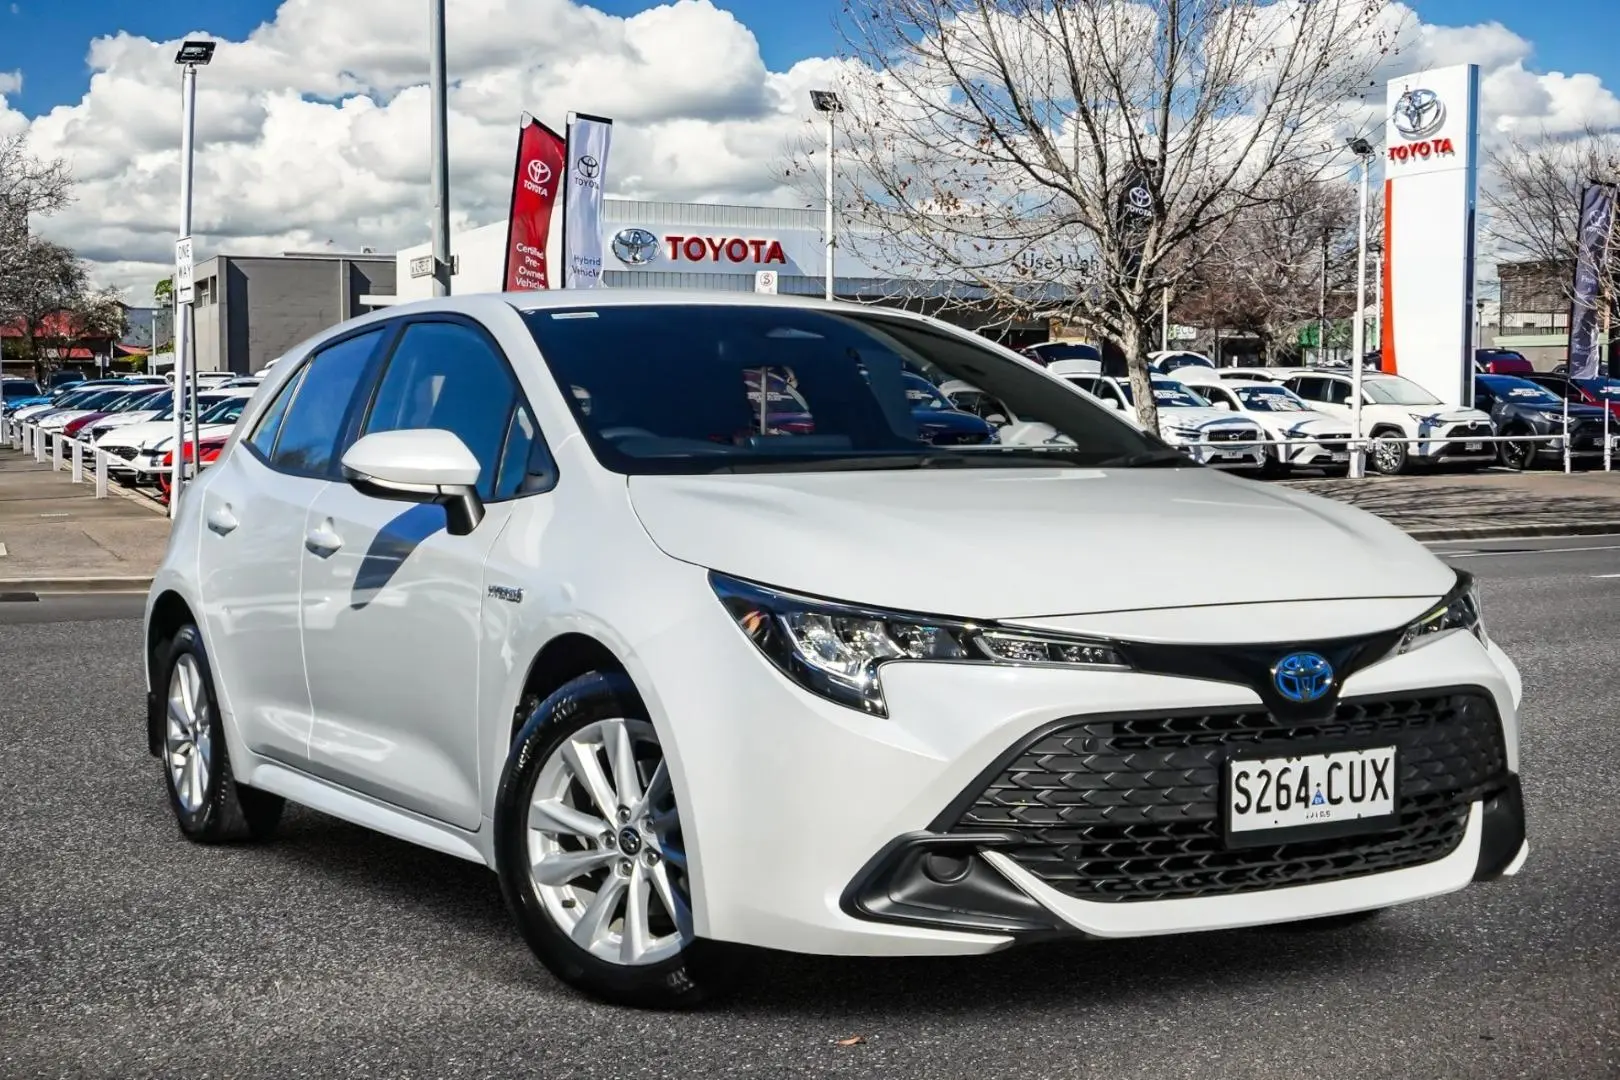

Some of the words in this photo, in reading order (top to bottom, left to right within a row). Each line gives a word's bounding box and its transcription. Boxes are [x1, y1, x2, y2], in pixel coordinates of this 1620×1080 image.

[1388, 138, 1454, 161] TOYOTA
[523, 180, 548, 197] TOYOTA
[575, 177, 600, 190] TOYOTA
[1124, 203, 1153, 218] TOYOTA
[665, 236, 787, 265] TOYOTA
[524, 256, 540, 268] Pre-
[573, 255, 601, 266] Hybrid
[518, 266, 545, 281] Owned
[1234, 765, 1311, 815] S264
[1327, 757, 1390, 806] CUX
